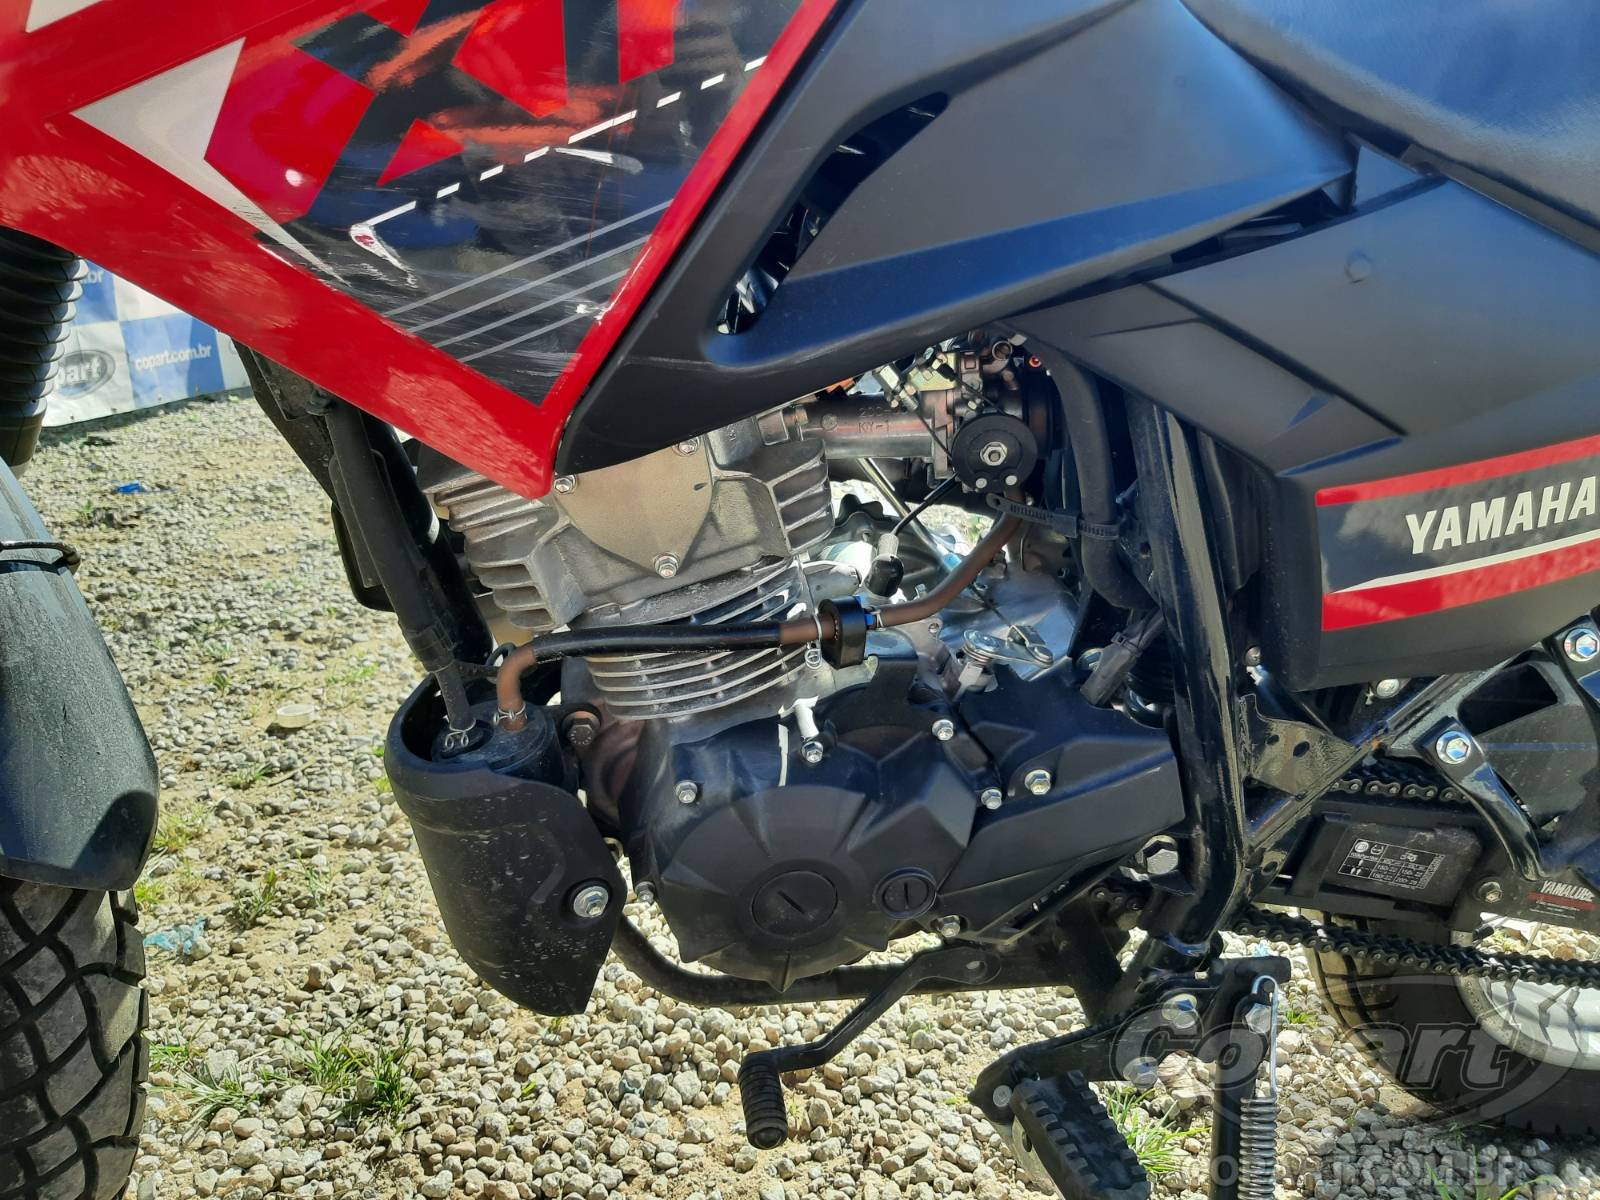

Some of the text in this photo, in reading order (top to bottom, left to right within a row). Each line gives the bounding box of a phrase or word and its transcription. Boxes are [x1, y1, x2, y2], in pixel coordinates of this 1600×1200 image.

[56, 356, 101, 388] part
[135, 344, 212, 372] copart.com.br
[1405, 476, 1597, 555] YAMAHA
